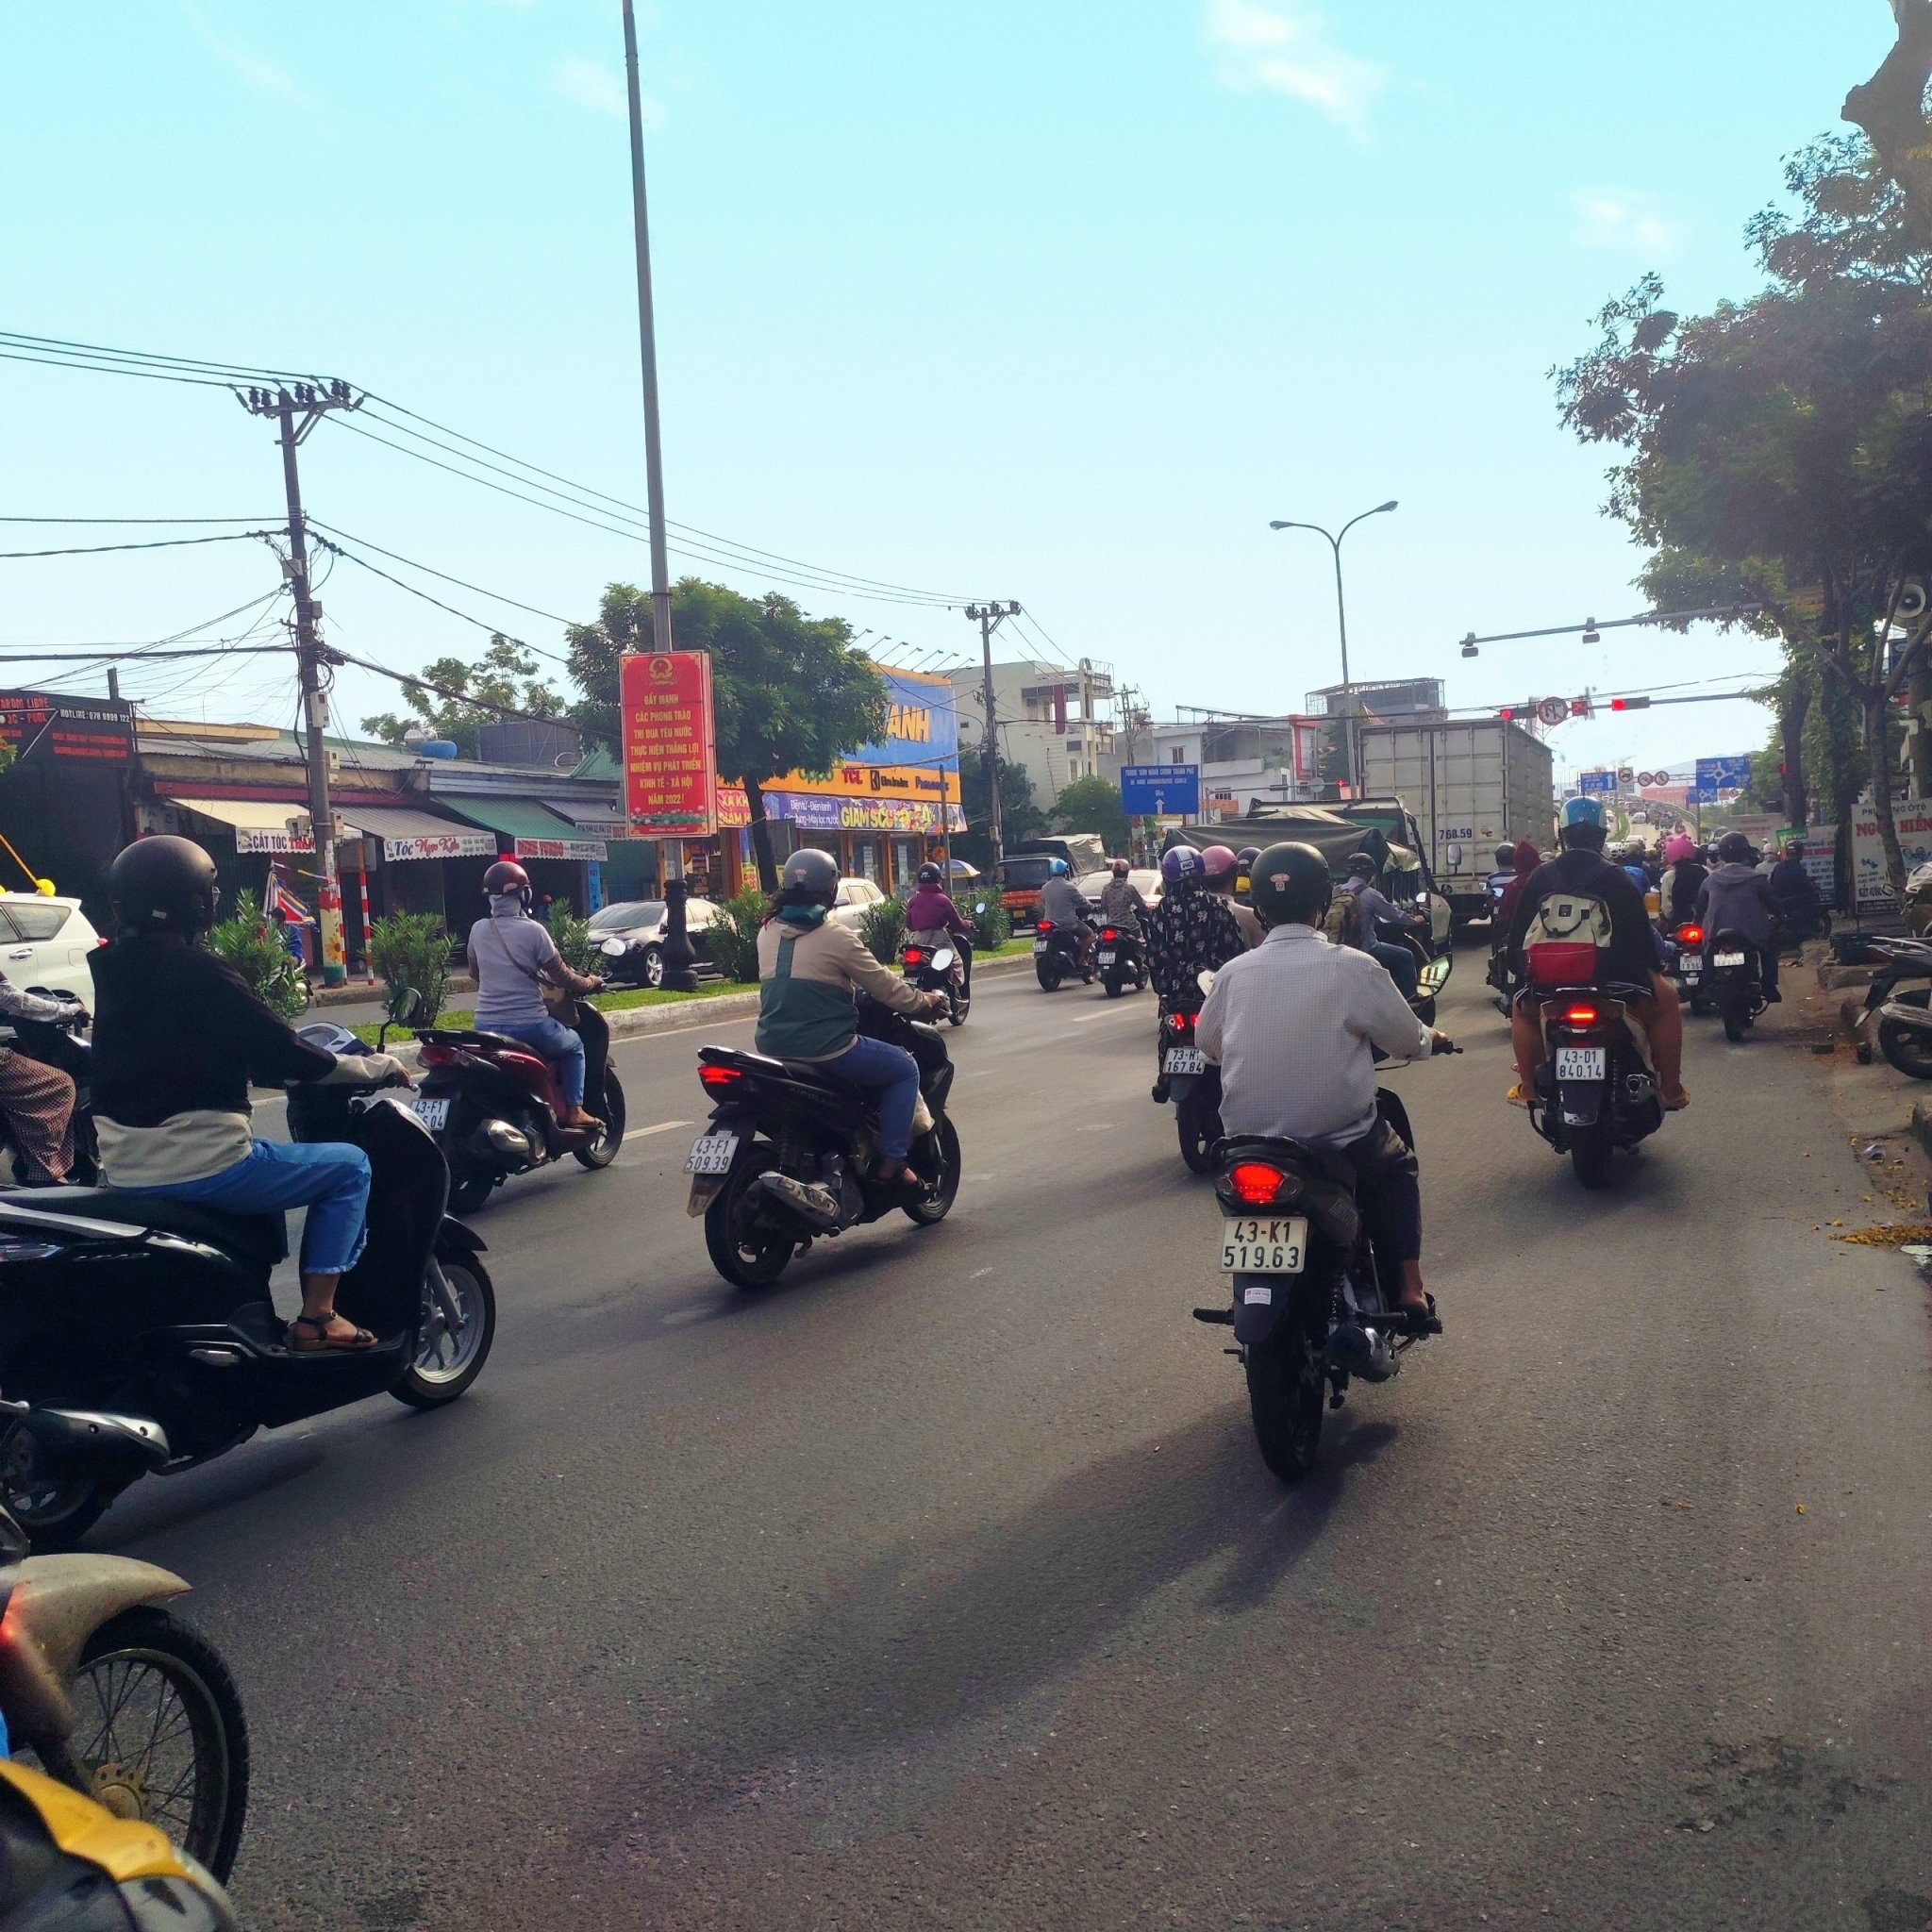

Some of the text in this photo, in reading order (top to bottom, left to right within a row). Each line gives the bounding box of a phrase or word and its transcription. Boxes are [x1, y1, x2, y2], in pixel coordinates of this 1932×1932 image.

[650, 710, 673, 722] PHONG
[842, 768, 863, 784] TCL
[253, 831, 269, 849] CẮT
[272, 834, 287, 849] TÓC
[1440, 828, 1473, 840] 768.59
[395, 841, 413, 856] Tóc
[1174, 1049, 1200, 1061] 73-H1
[1168, 1061, 1202, 1073] 167.84
[1559, 1064, 1602, 1078] 840.14
[415, 1100, 443, 1114] 43-F1
[696, 1140, 729, 1155] 43-F1
[686, 1156, 729, 1171] 509.39
[1234, 1221, 1291, 1243] 43-K1
[1224, 1245, 1299, 1269] 519.63
